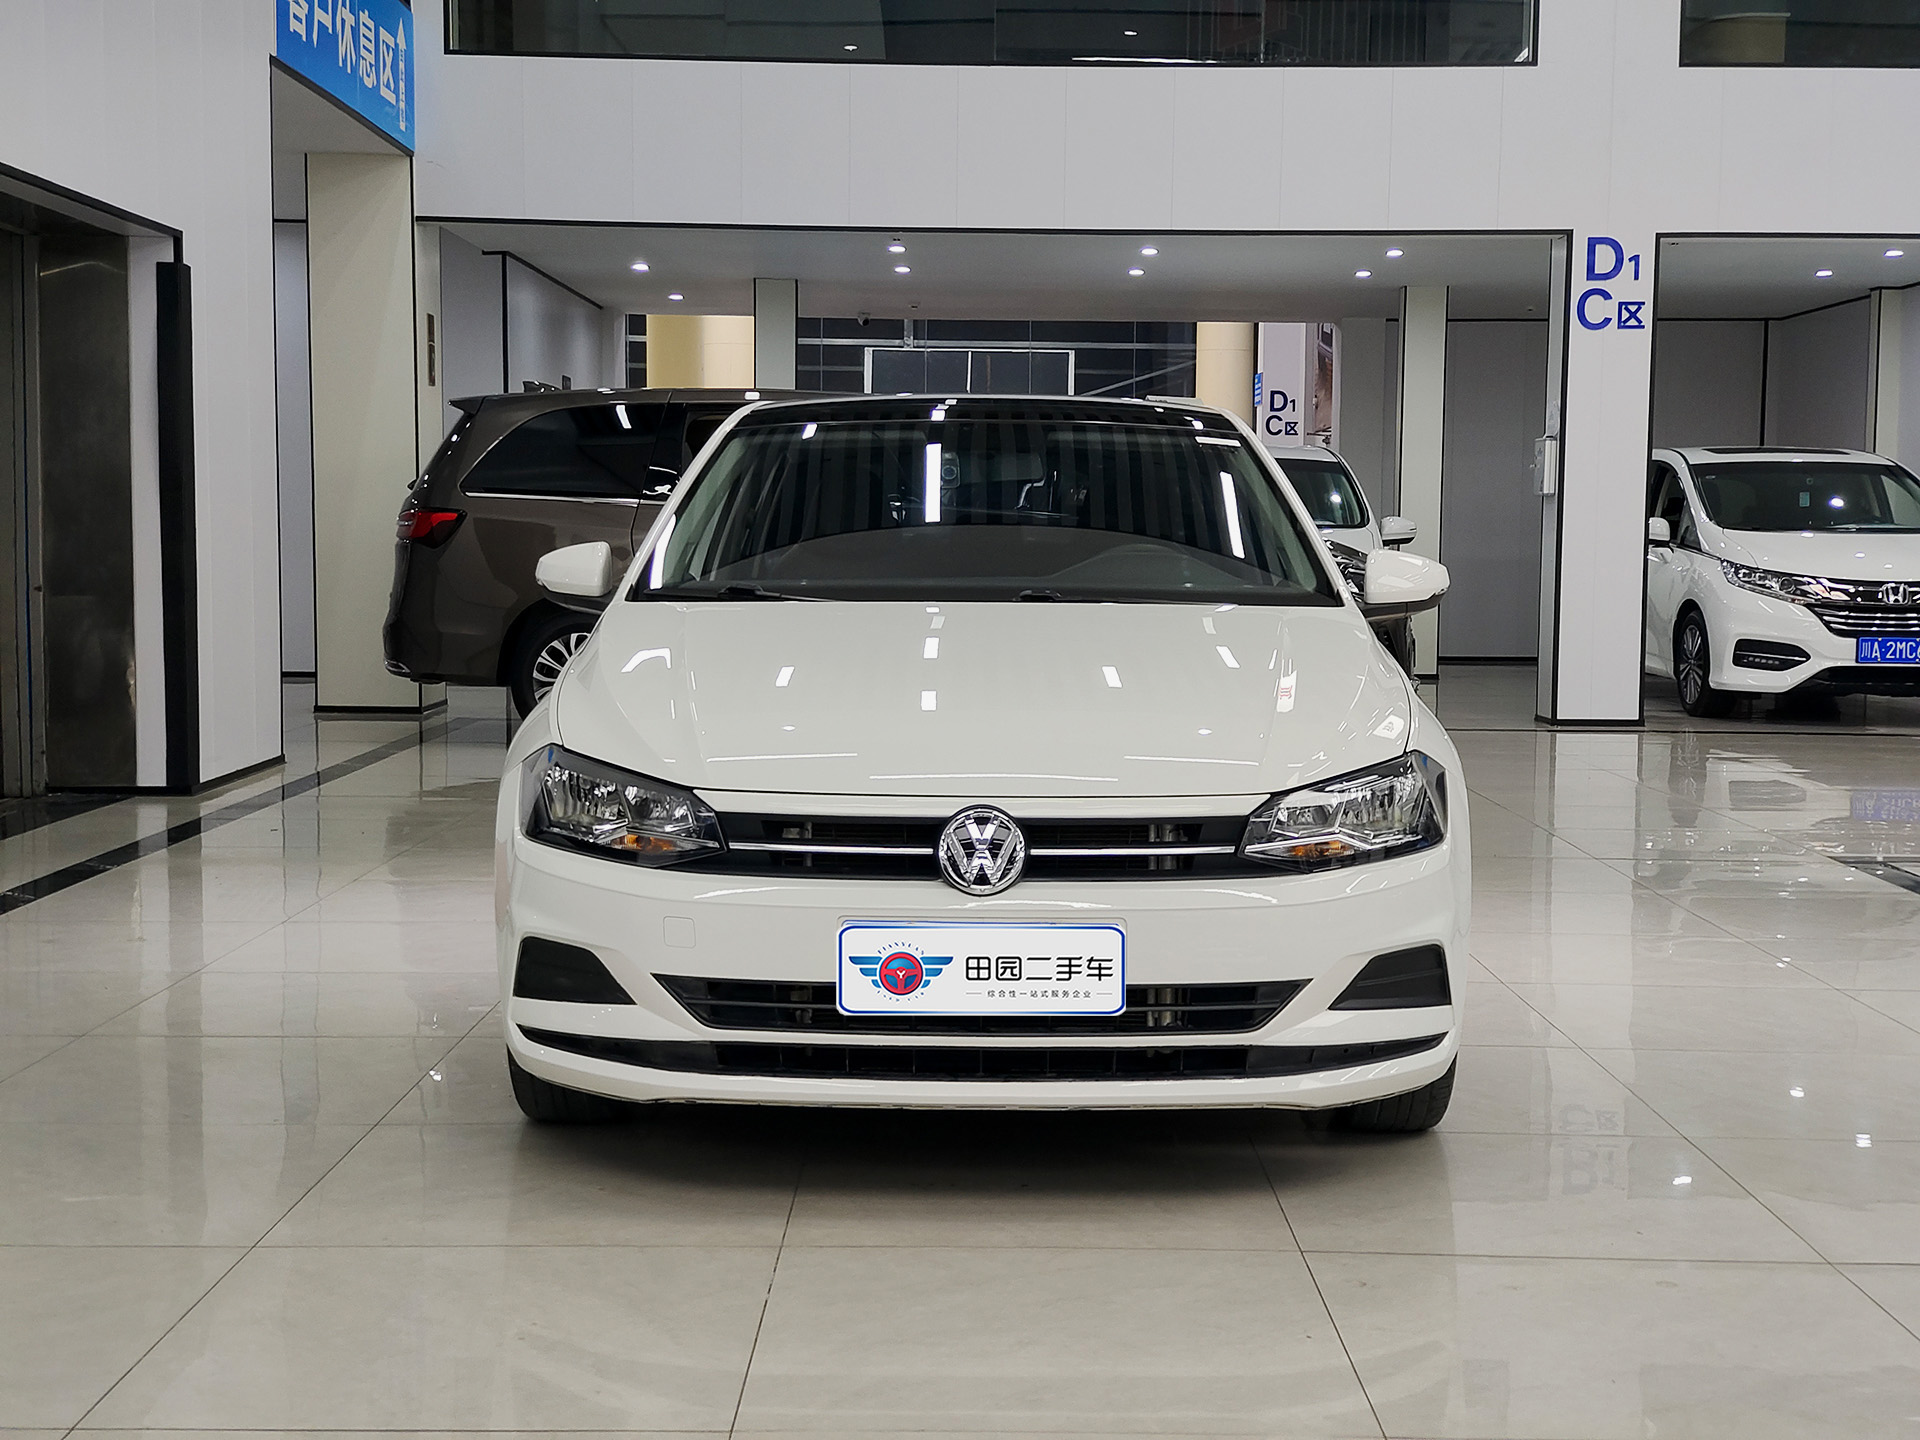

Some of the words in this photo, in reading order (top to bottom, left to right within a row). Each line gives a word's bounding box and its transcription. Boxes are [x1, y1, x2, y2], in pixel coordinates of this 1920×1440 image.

[1586, 236, 1641, 281] D1
[1576, 287, 1646, 330] C区
[1269, 390, 1296, 413] D1
[1265, 414, 1299, 436] C区
